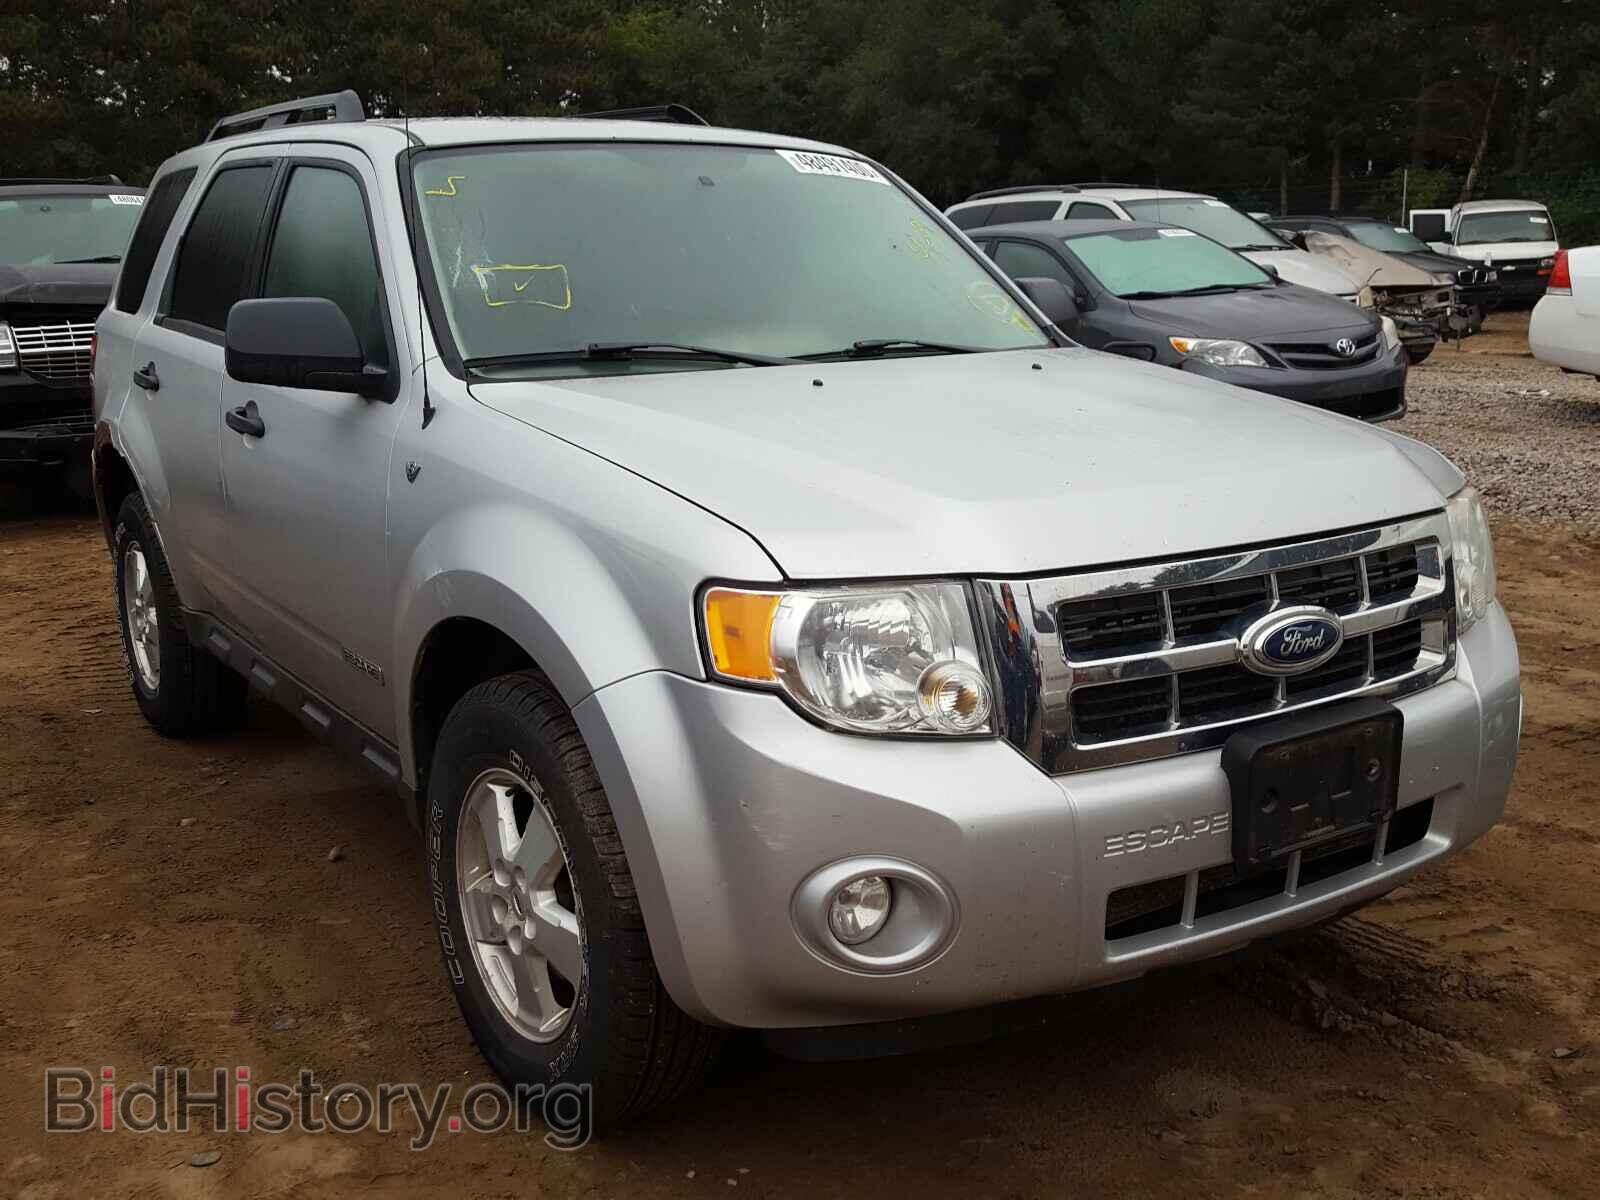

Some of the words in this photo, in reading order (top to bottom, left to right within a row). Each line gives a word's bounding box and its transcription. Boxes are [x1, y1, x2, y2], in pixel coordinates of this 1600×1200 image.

[1280, 625, 1325, 656] Ford
[1104, 811, 1229, 857] ESCAPE
[429, 799, 464, 985] COOPER
